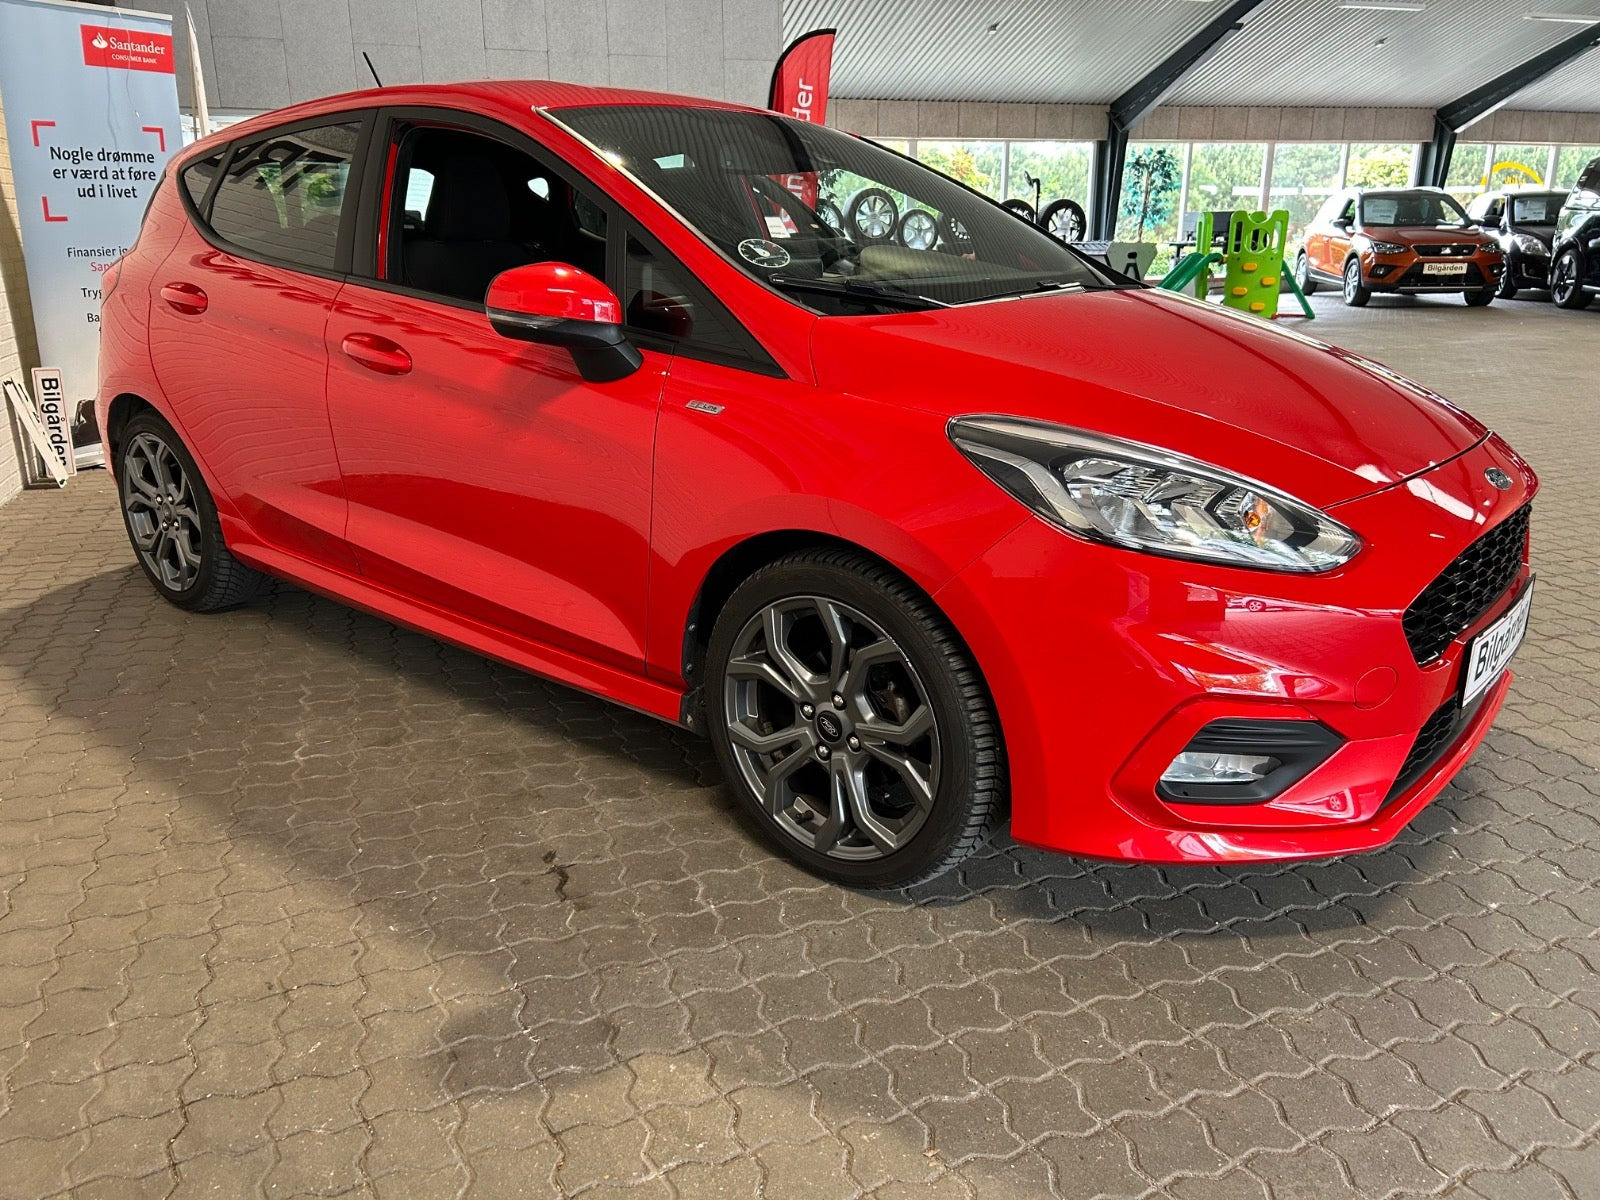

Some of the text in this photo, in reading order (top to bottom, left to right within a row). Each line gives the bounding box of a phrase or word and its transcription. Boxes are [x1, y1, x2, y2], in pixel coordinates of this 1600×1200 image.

[109, 36, 166, 55] Santander
[111, 53, 157, 64] CONSUMER BANK
[49, 146, 155, 165] Nogle drømme
[52, 166, 156, 181] er værd at føre
[77, 184, 138, 198] ud i livet
[67, 246, 116, 258] Finansier
[1427, 264, 1463, 272] Bilgården
